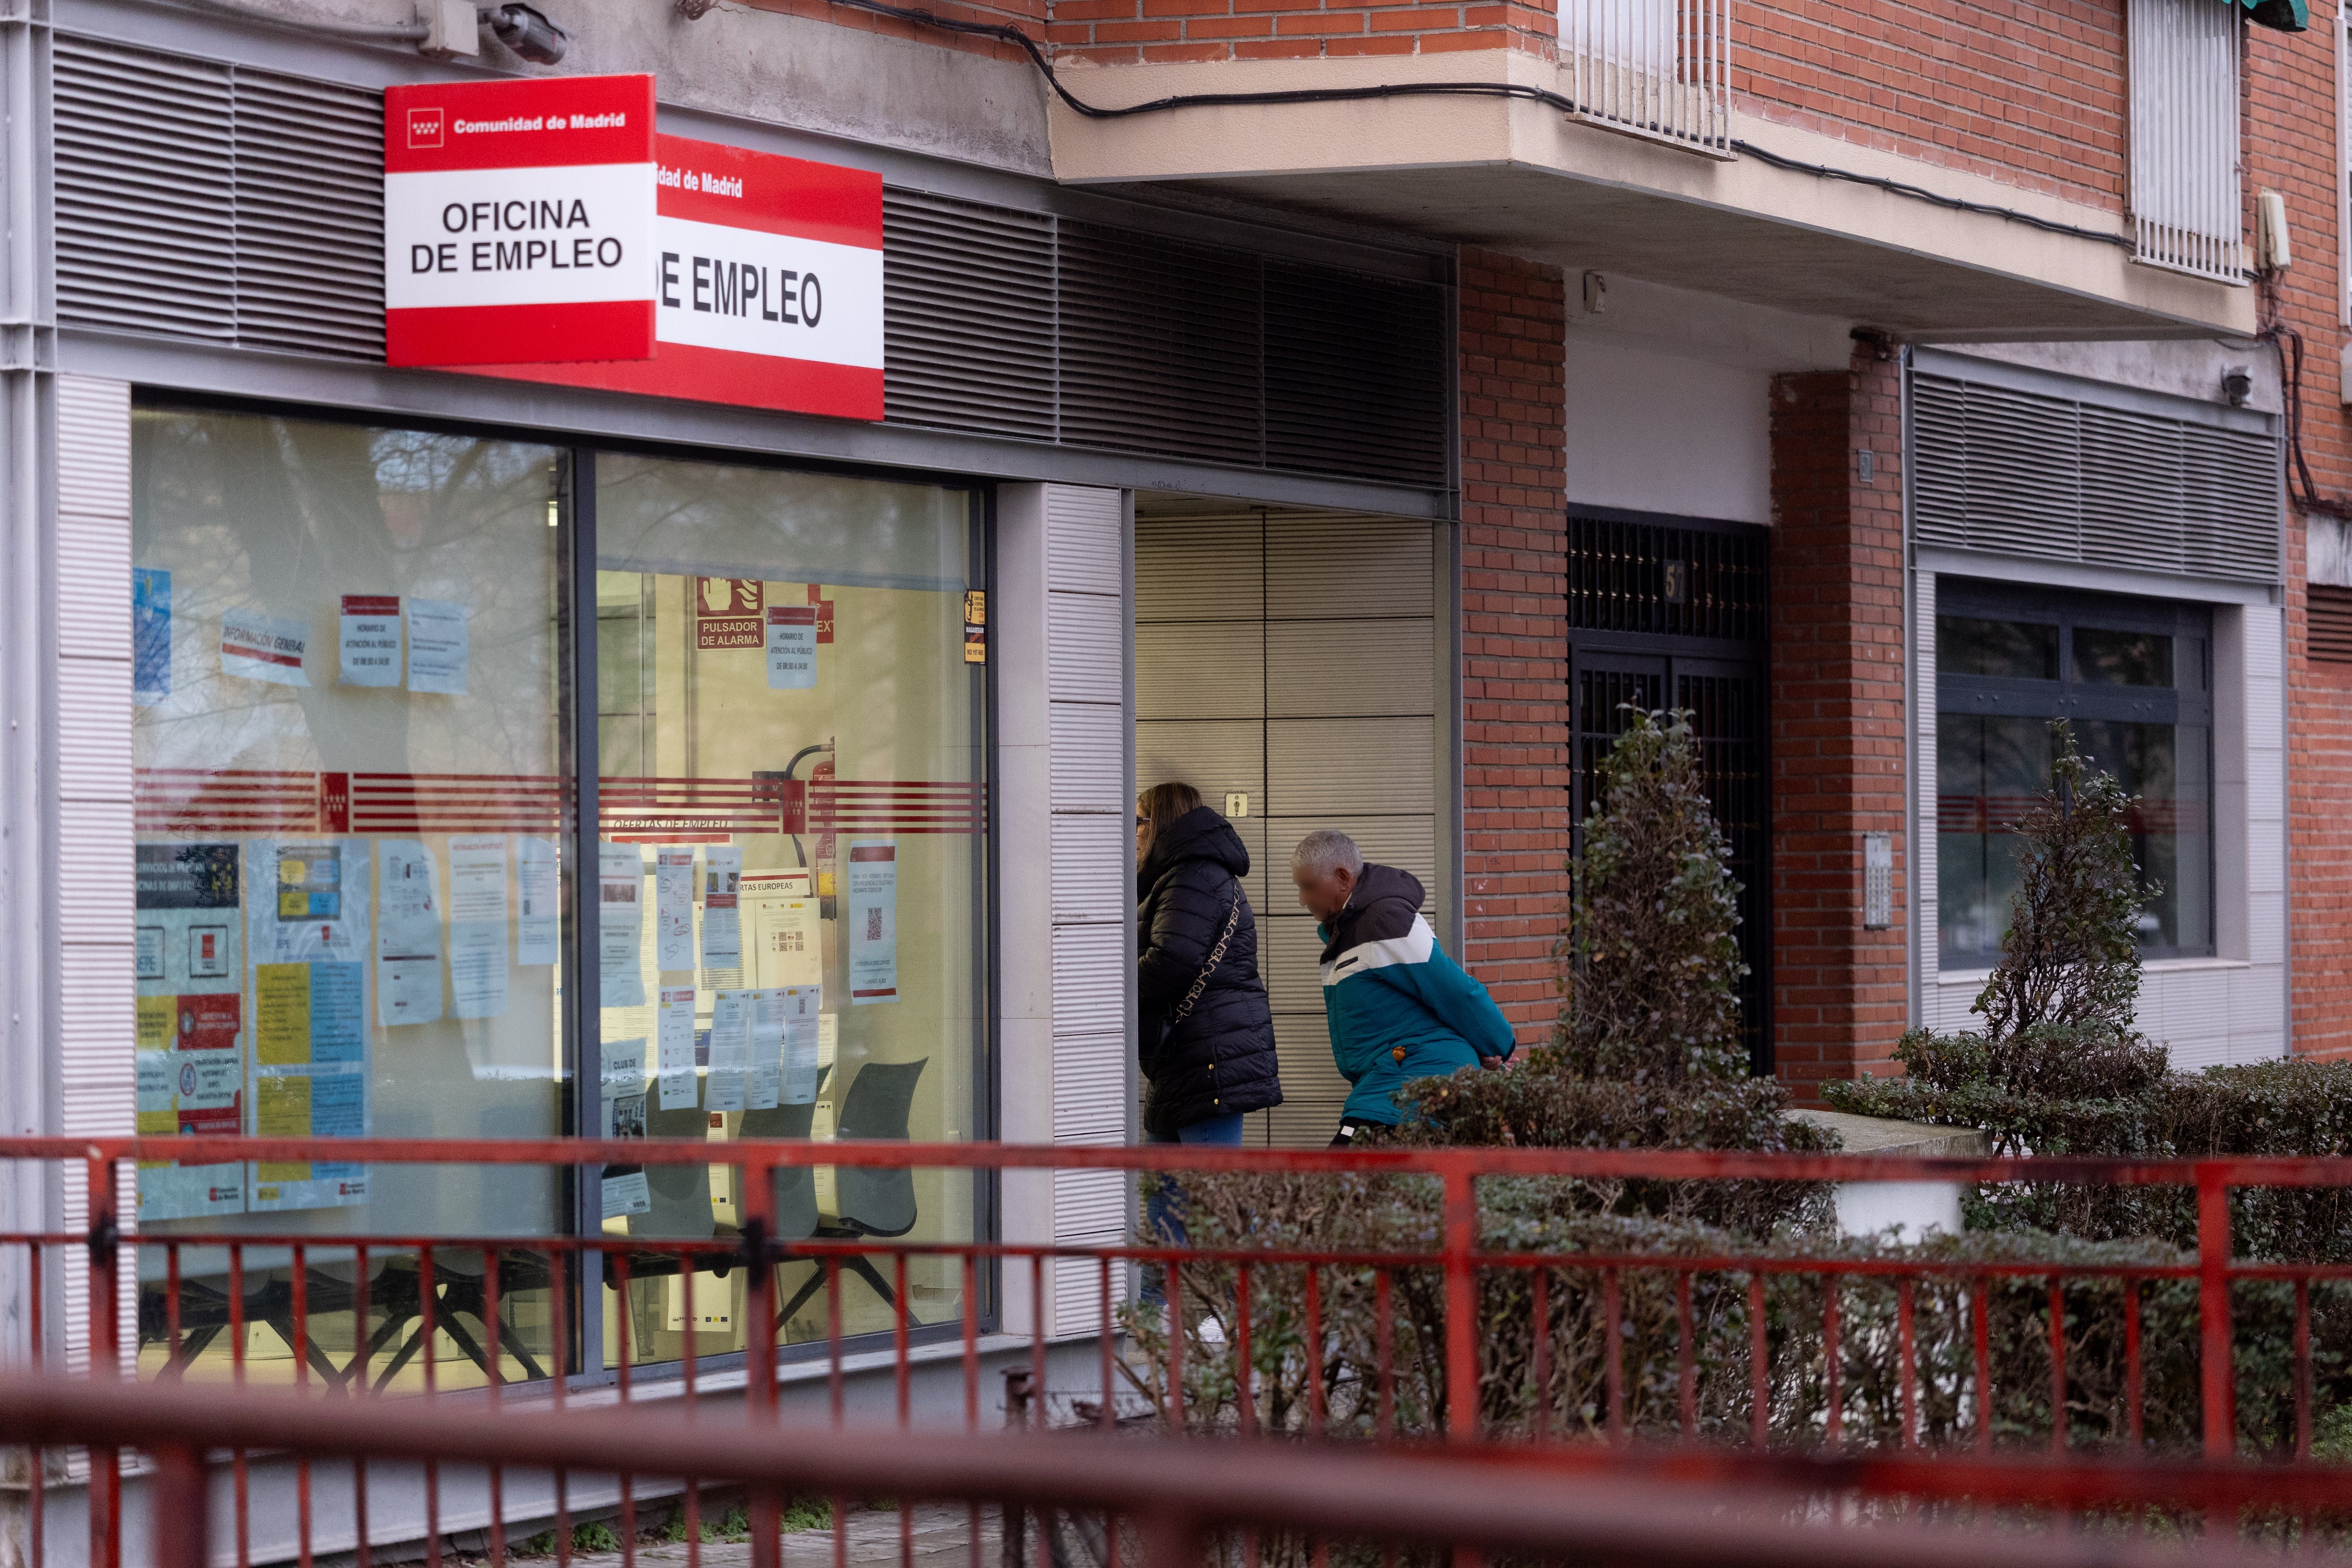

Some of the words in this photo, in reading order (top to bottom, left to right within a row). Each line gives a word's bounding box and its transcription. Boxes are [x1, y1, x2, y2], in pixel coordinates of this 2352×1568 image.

[455, 117, 542, 133] Comunidad
[547, 117, 566, 129] de
[571, 113, 625, 128] Madrid
[683, 170, 699, 190] de
[701, 172, 742, 198] Madrid
[443, 199, 588, 233] OFICINA
[412, 244, 457, 273] DE
[472, 238, 621, 271] EMPLEO
[656, 252, 680, 308] E
[694, 257, 821, 328] EMPLEO
[703, 621, 757, 633] PULSADOR
[817, 620, 834, 633] EX
[224, 626, 273, 647] INFORMACIÓN
[274, 636, 306, 654] GENERAL
[701, 636, 715, 646] DE
[717, 634, 759, 645] ALARMA
[771, 645, 790, 655] ATENCIÓN
[758, 882, 793, 891] EUROPEAS
[613, 1060, 628, 1070] CLUB
[629, 1058, 636, 1068] DE
